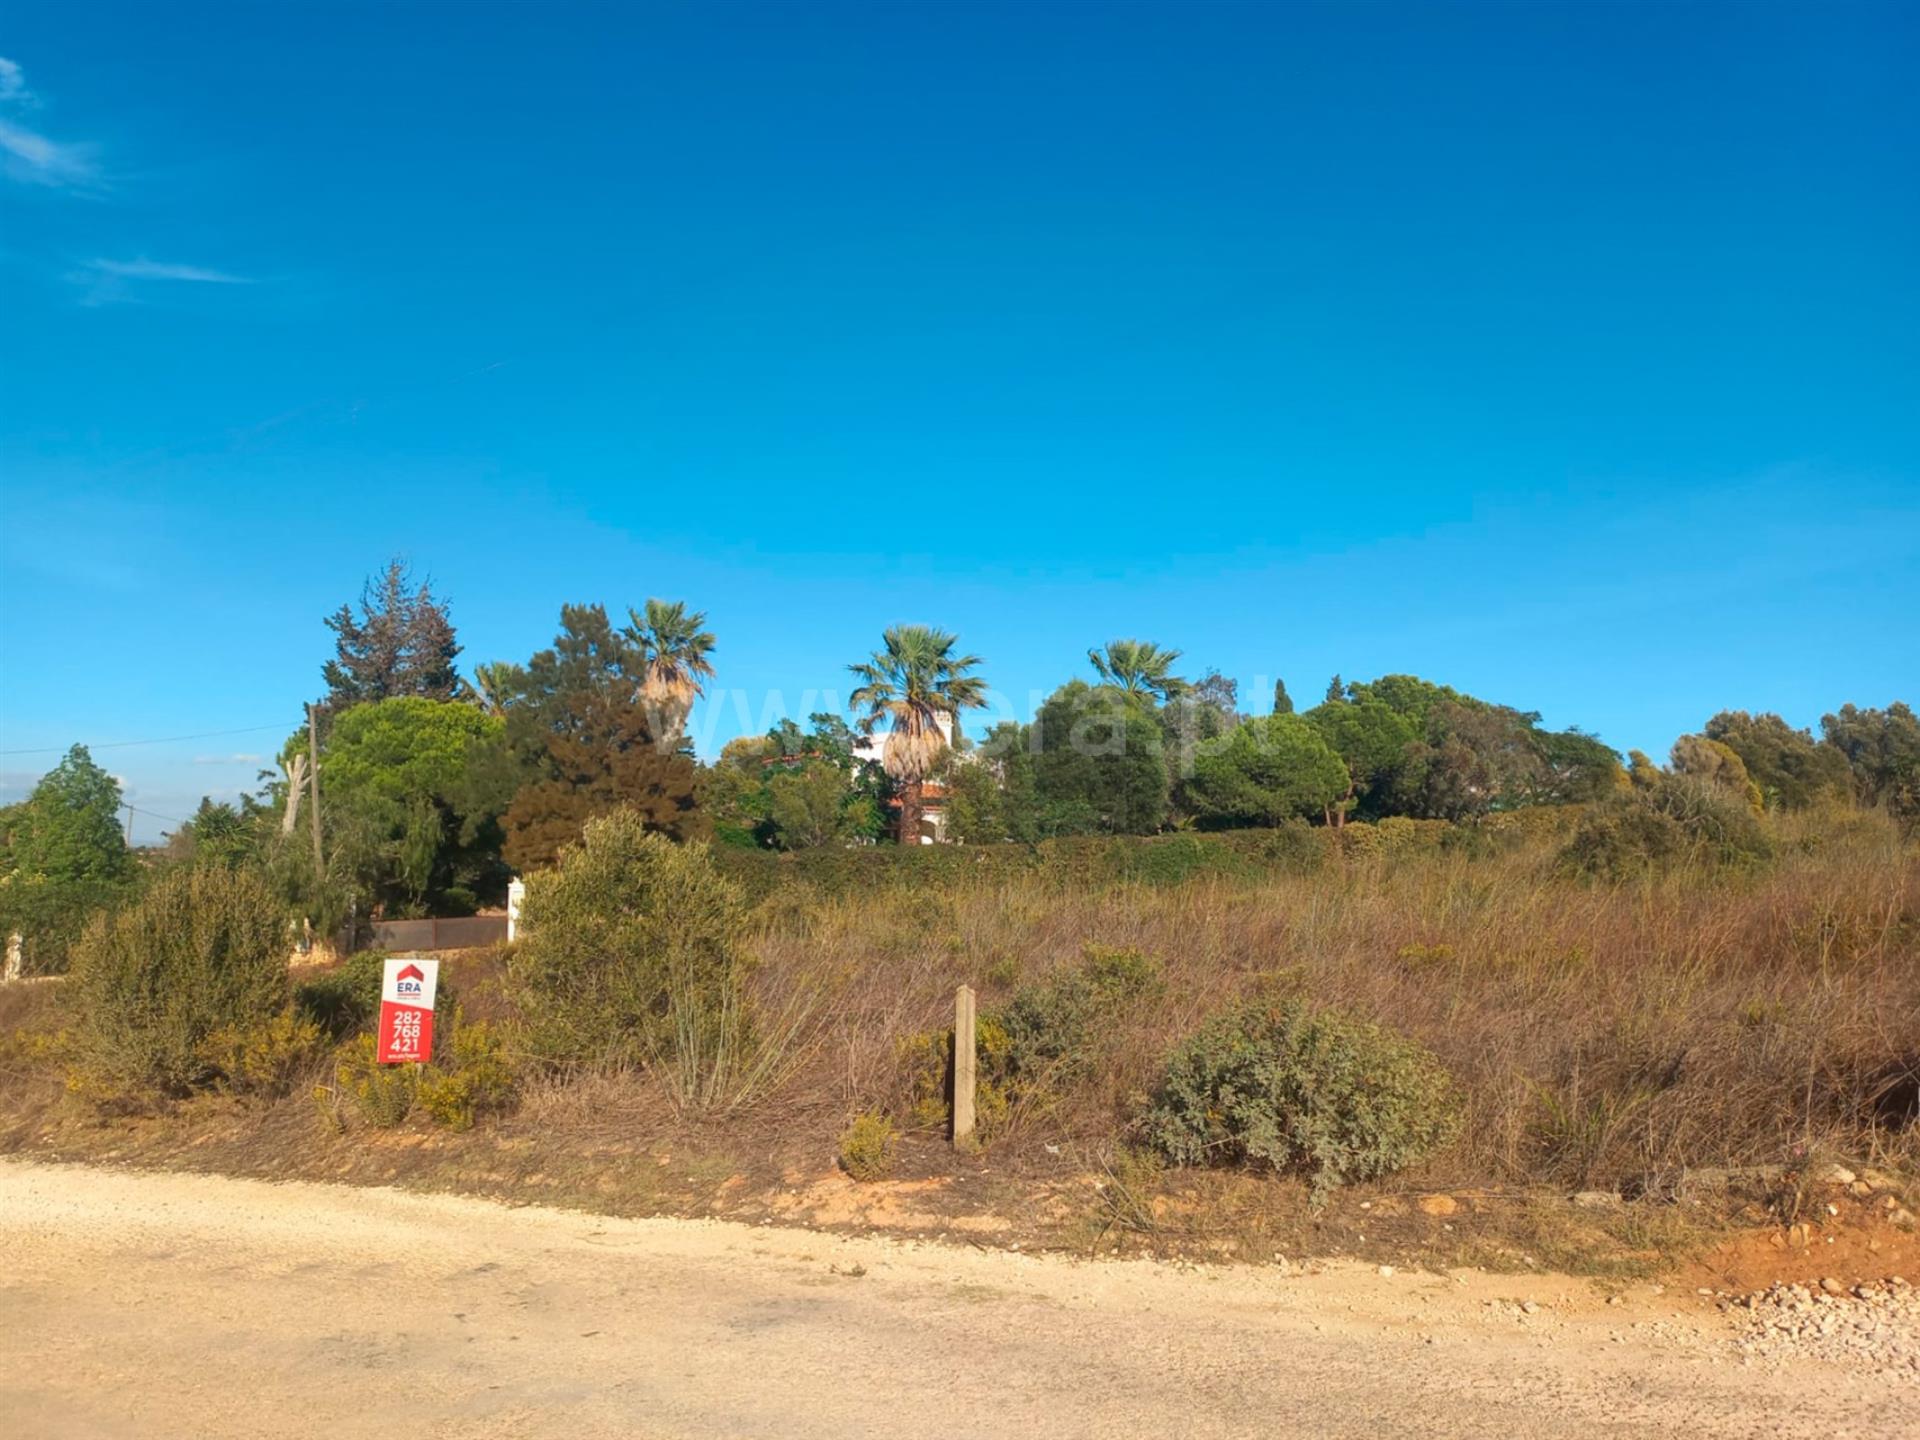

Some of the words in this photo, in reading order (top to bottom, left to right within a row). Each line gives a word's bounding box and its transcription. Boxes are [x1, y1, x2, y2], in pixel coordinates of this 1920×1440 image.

[397, 982, 421, 992] ERA
[393, 1011, 422, 1025] 282
[393, 1025, 420, 1038] 768
[390, 1039, 418, 1052] 421
